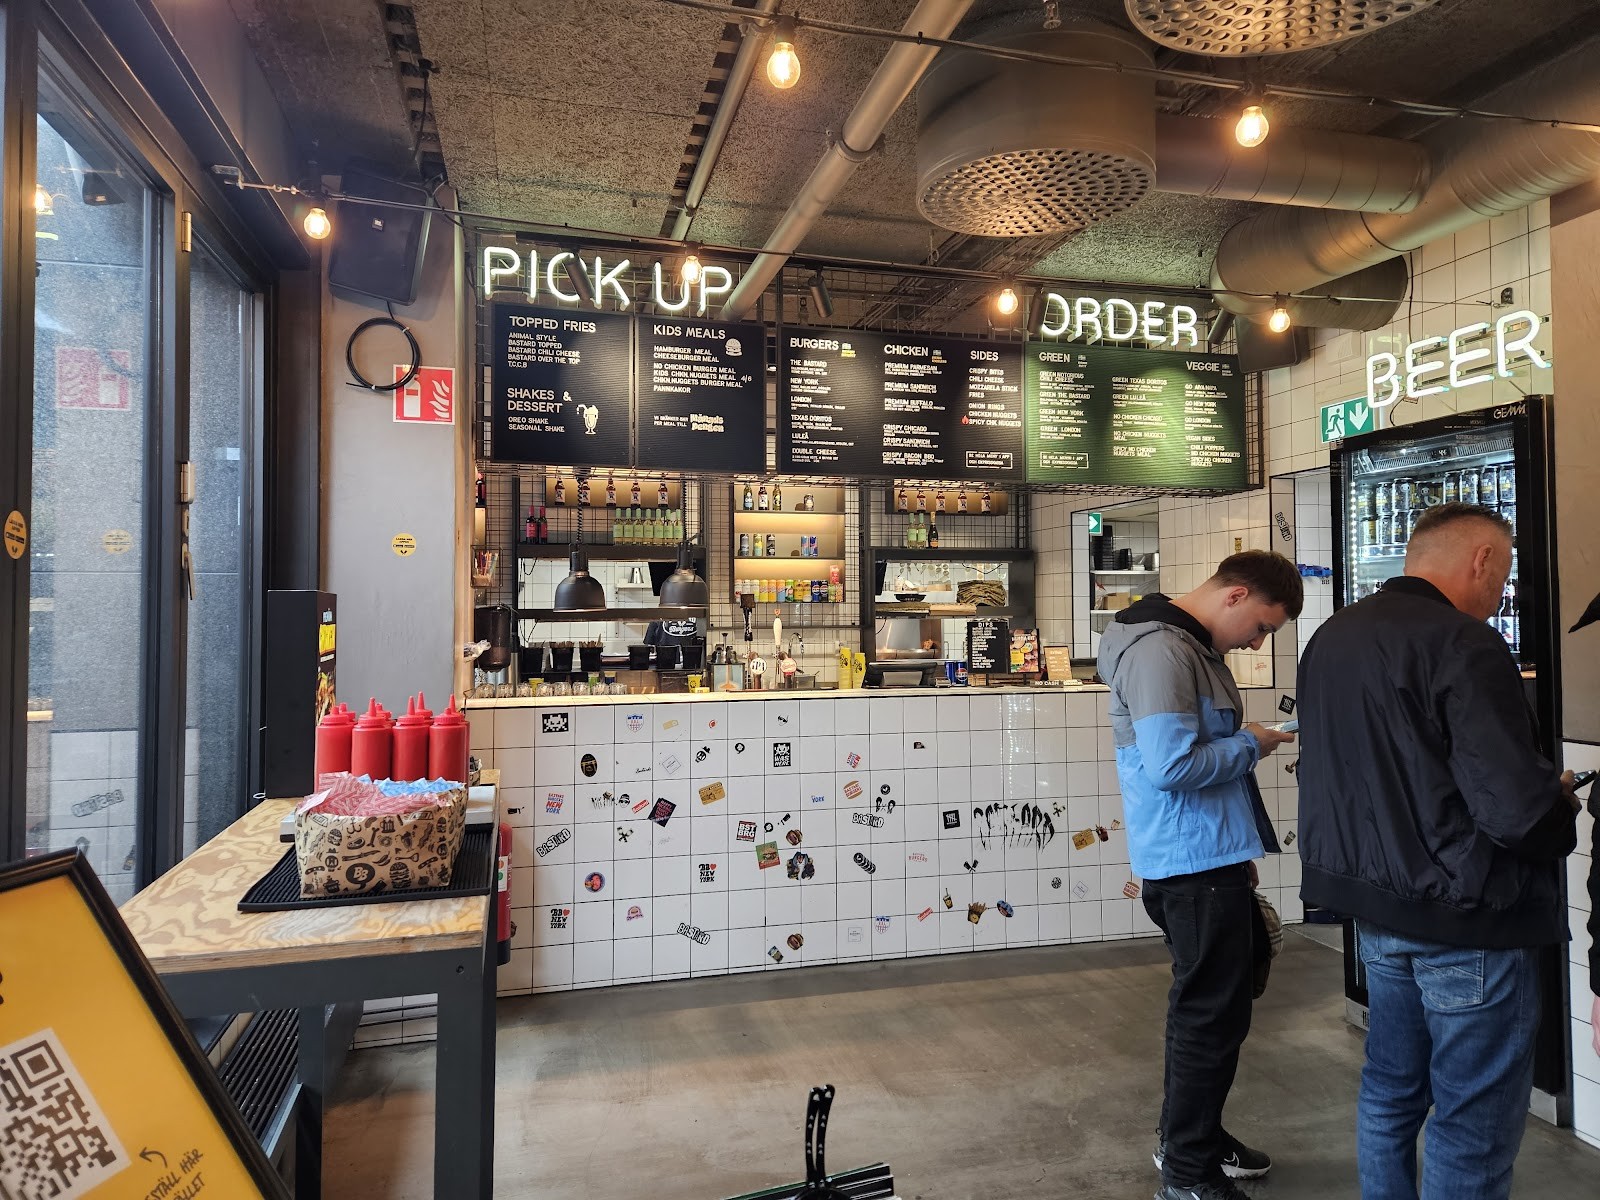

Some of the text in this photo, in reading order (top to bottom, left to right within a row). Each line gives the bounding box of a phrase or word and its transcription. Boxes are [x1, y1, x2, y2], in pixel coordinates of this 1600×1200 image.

[484, 246, 733, 314] PICK UP
[509, 316, 596, 333] TOPPED FRIES
[1041, 293, 1198, 346] ORDER
[653, 324, 725, 339] KIDS MEALS
[790, 338, 839, 350] BURGERS
[884, 344, 928, 356] CHICKEN
[654, 353, 701, 361] CHEESEBURGER
[970, 350, 999, 361] SIDES
[1039, 352, 1070, 362] GREEN
[1366, 310, 1552, 408] BEER
[1186, 361, 1220, 371] VEGGIE
[507, 388, 572, 401] SHAKES &
[508, 400, 563, 413] DESSERT
[1275, 512, 1292, 541] BASTARD
[739, 823, 756, 831] BST
[852, 813, 884, 828] BASTARD
[536, 828, 571, 857] BASTARD
[353, 866, 369, 881] BB
[677, 923, 710, 945] BASTARD
[145, 1149, 203, 1200] STÄLL HÄR
